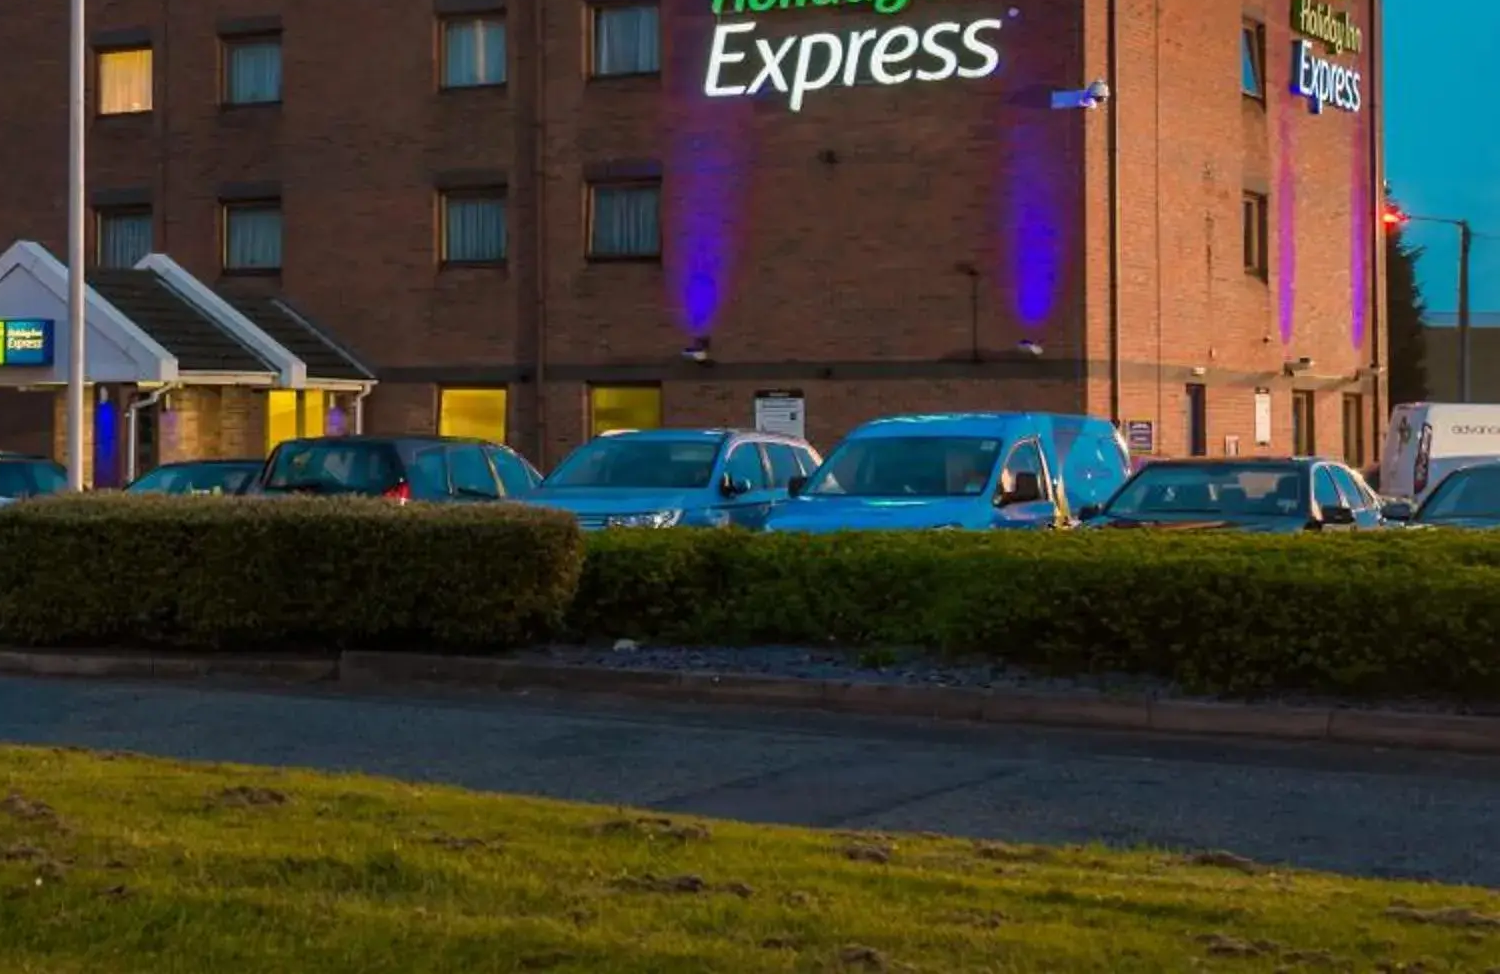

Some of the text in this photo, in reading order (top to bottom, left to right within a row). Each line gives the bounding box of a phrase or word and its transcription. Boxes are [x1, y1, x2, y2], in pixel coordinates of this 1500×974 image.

[703, 18, 1003, 112] Express
[1344, 11, 1363, 54] Inn
[1299, 39, 1362, 115] Express
